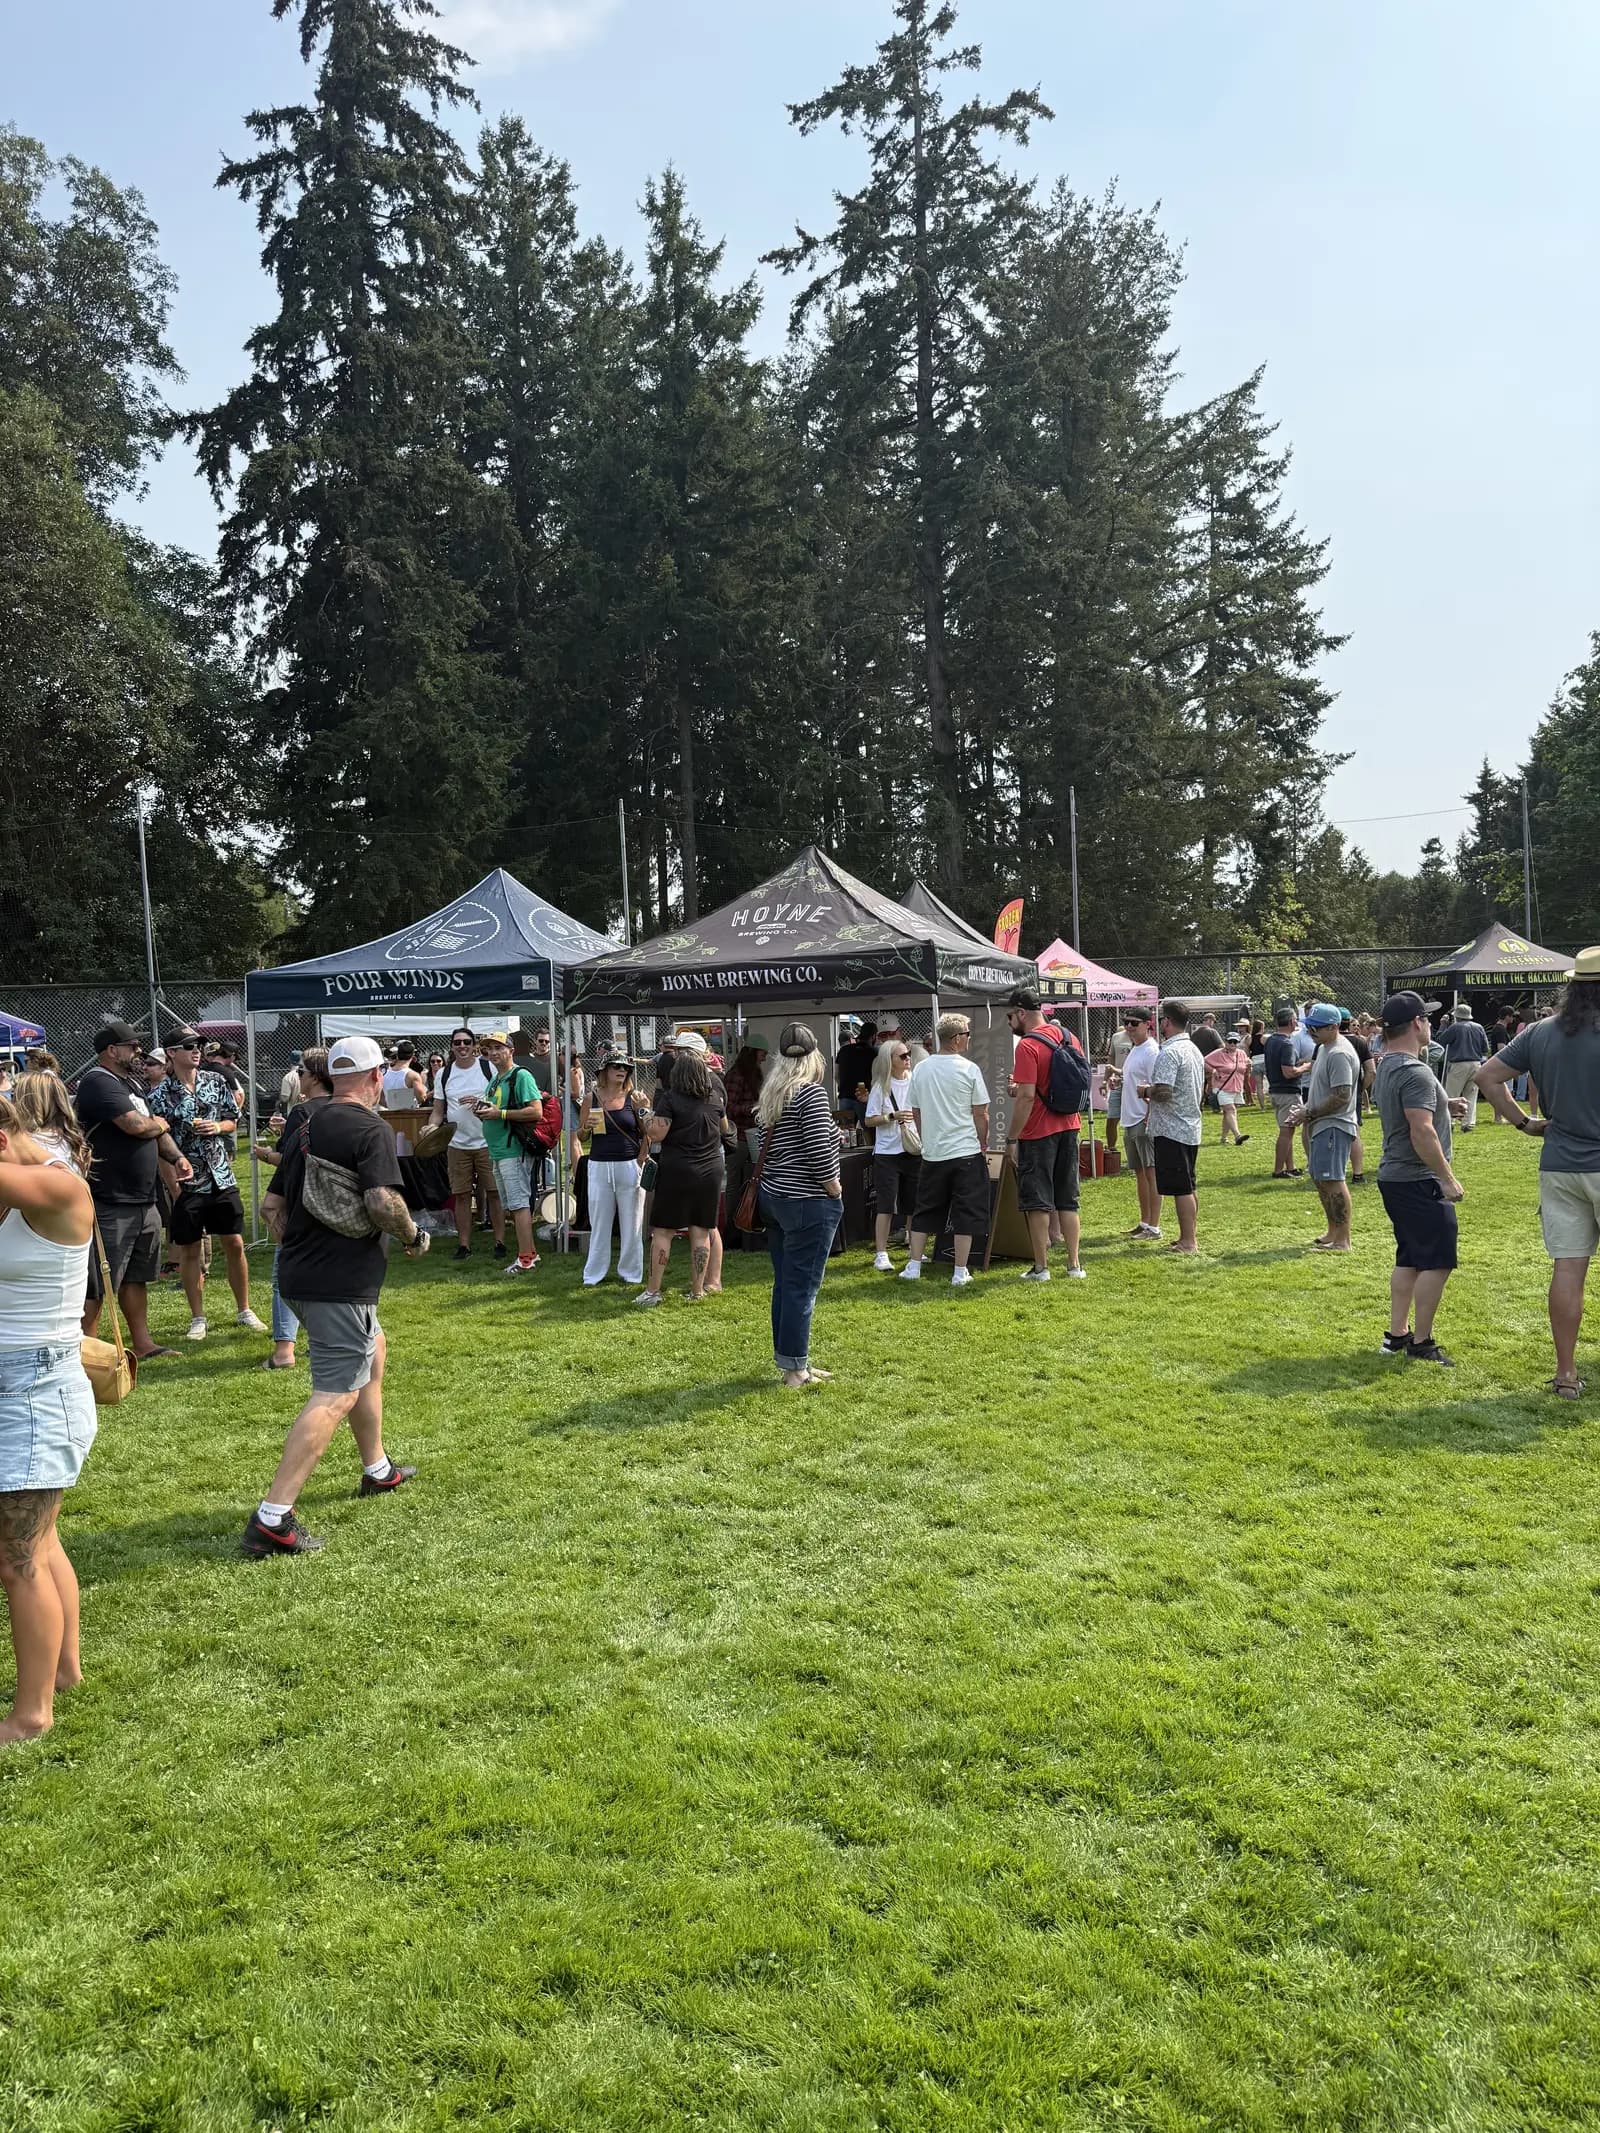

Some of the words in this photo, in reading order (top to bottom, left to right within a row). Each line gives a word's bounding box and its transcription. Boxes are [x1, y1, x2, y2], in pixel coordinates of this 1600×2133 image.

[731, 904, 832, 927] HOYNE
[322, 971, 384, 996] FOUR
[387, 969, 464, 990] WINDS
[661, 973, 715, 991] HOYNE
[716, 967, 793, 988] BREWING
[795, 966, 823, 982] CO.
[1465, 972, 1491, 985] NEVER
[1493, 972, 1506, 984] HIT
[1510, 972, 1526, 984] THE
